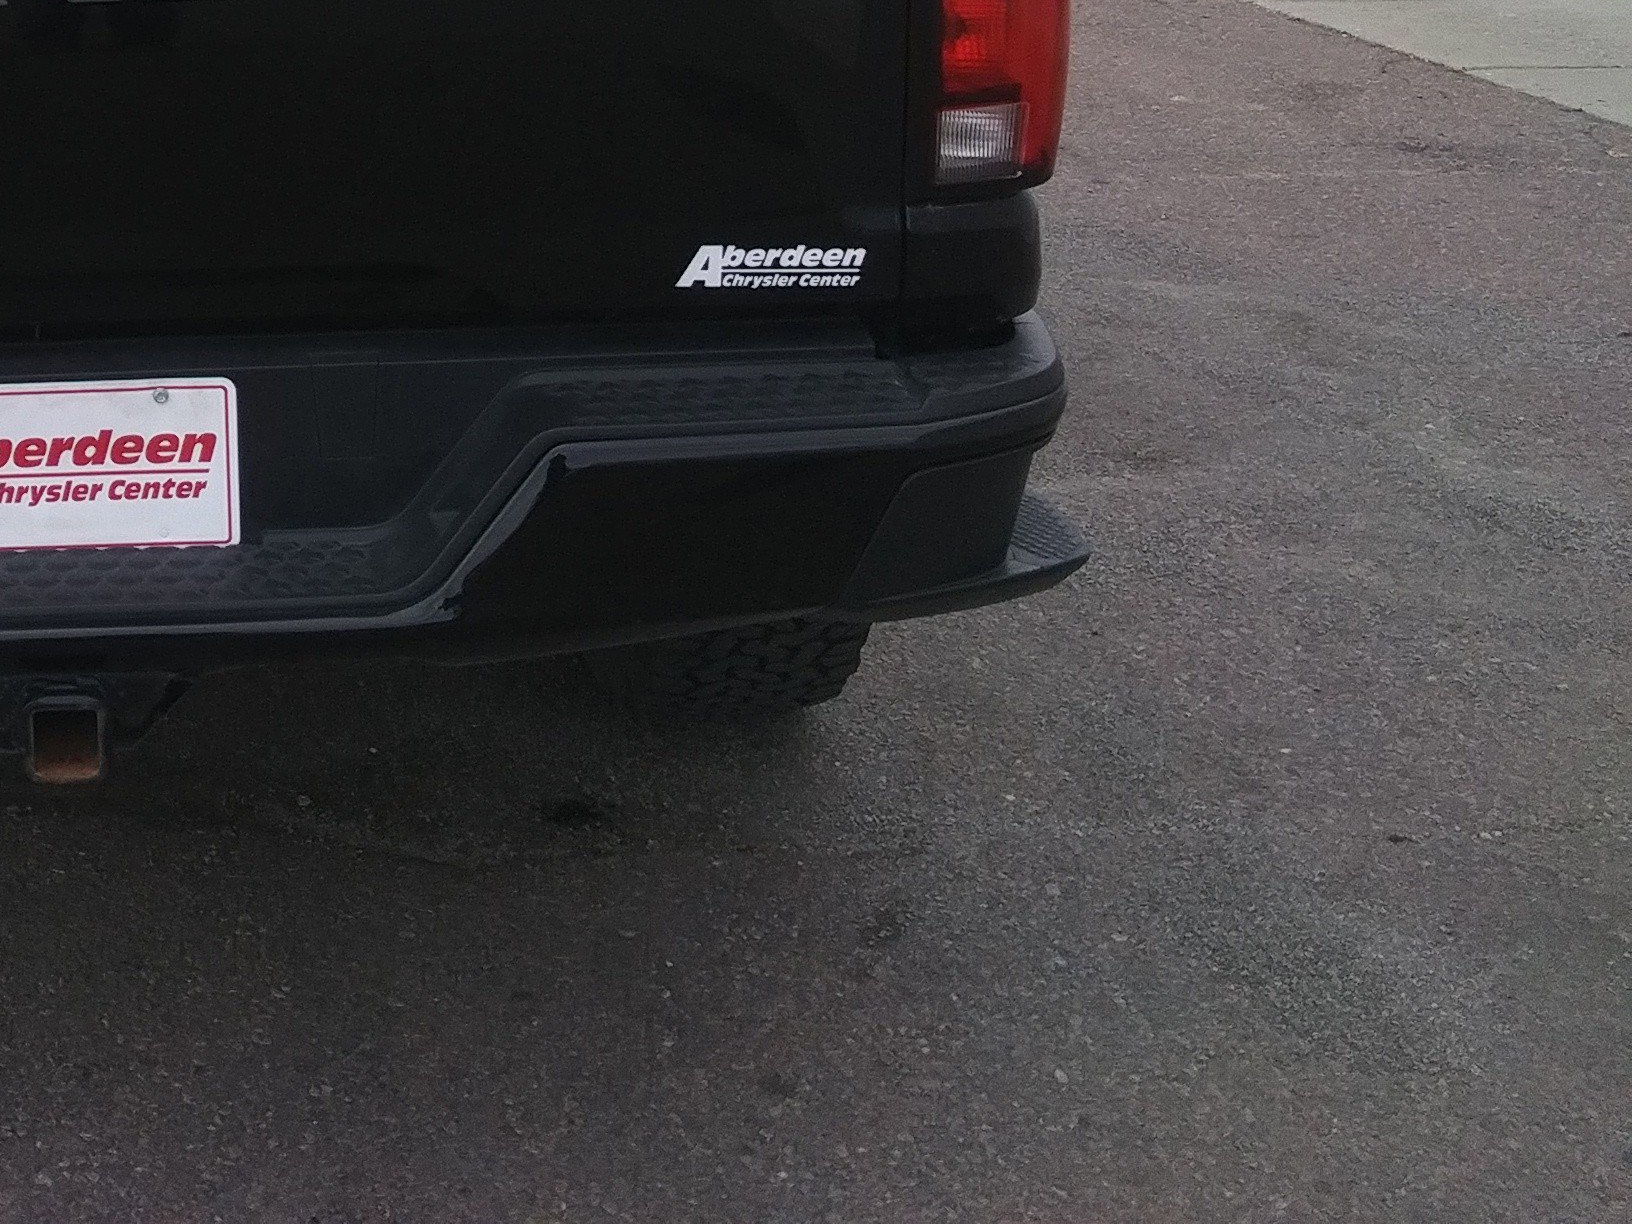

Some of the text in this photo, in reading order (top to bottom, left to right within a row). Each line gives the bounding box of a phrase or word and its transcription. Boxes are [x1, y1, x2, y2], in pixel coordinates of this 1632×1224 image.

[675, 243, 866, 288] Aberdeen
[722, 273, 861, 289] Chrysler Center
[107, 476, 208, 500] Center
